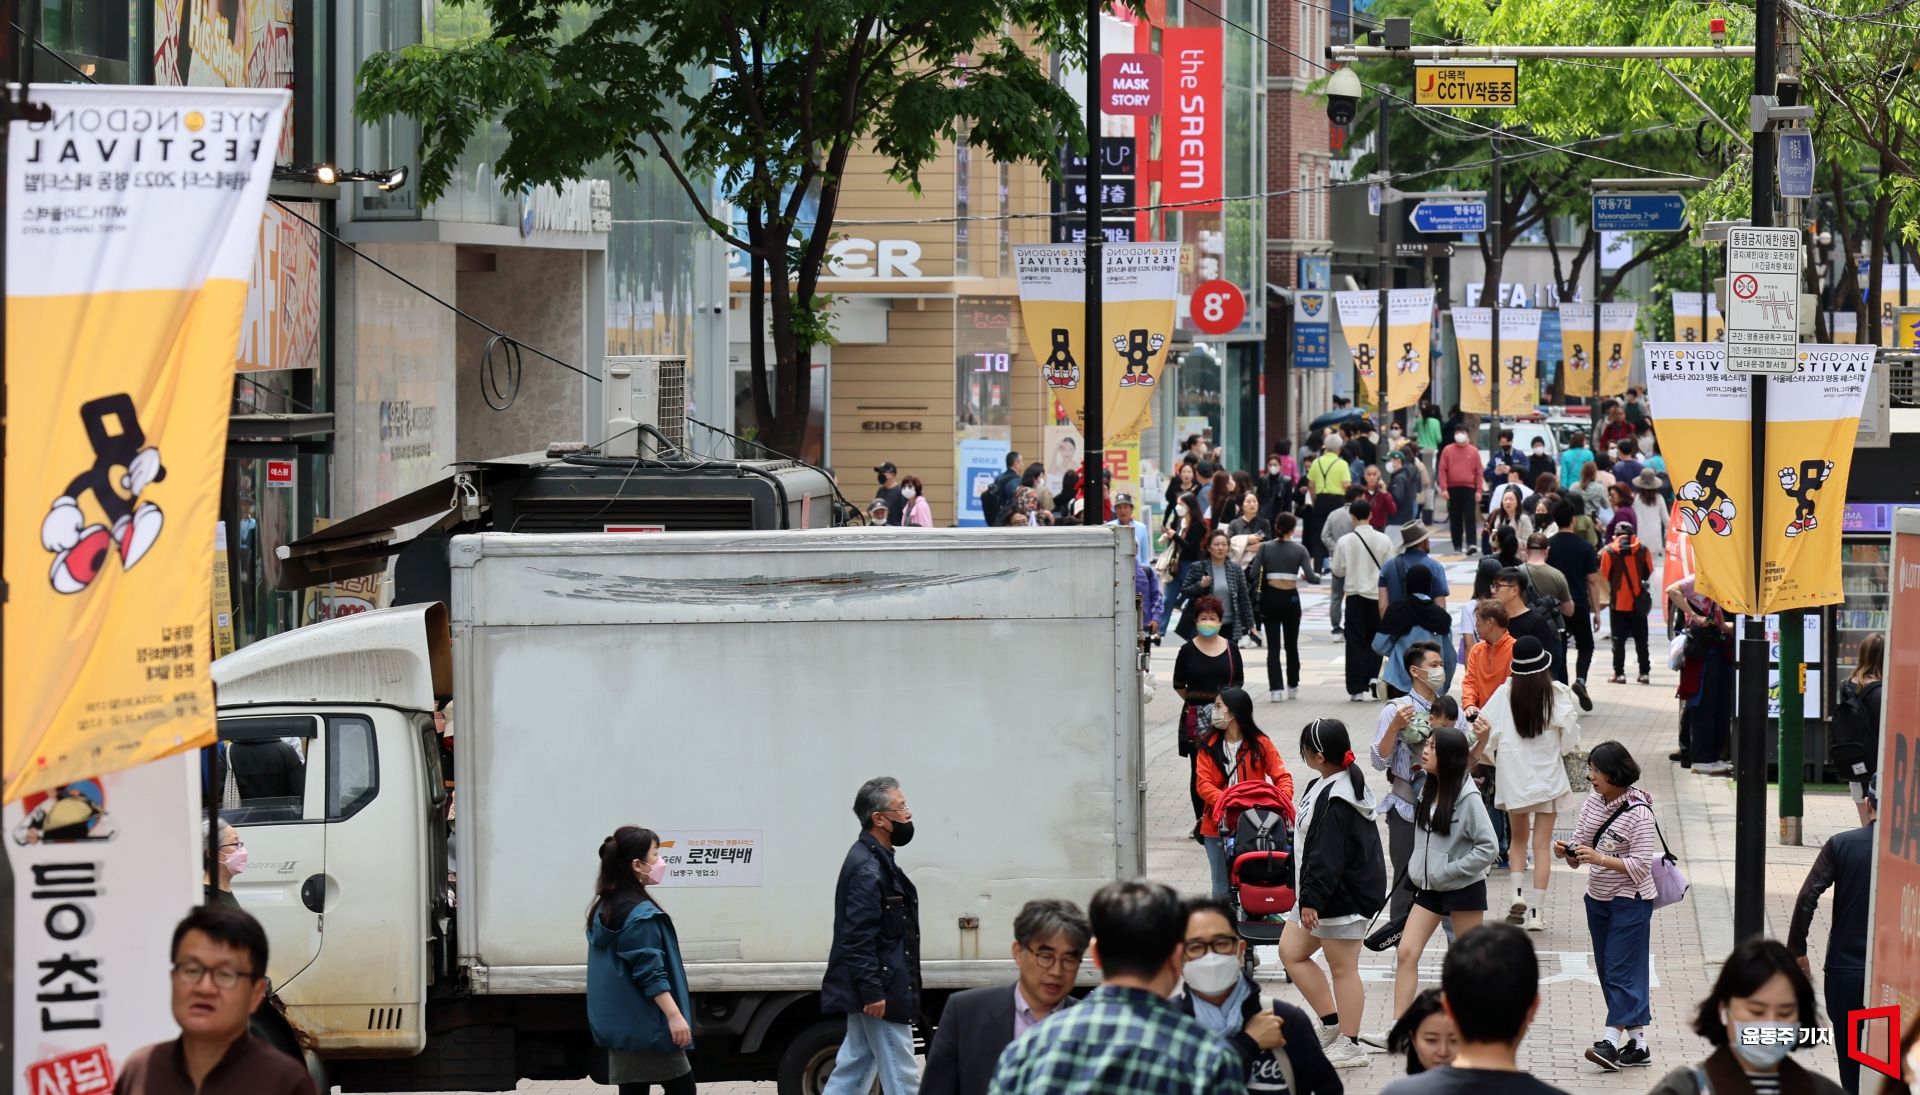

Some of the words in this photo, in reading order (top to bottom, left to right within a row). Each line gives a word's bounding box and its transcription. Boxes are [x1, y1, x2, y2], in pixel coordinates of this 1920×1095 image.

[1120, 62, 1144, 74] ALL
[1180, 49, 1204, 88] the
[1438, 70, 1466, 80] 다목적
[1113, 78, 1150, 90] MASK
[1437, 82, 1513, 102] CCTV작동중
[1111, 95, 1151, 107] STORY
[1597, 198, 1632, 210] 명동7길
[1429, 216, 1468, 224] Myeongdong
[1597, 212, 1642, 220] Myeongdong
[1643, 212, 1659, 220] 7-gil
[1072, 229, 1130, 243] 보게임
[1733, 232, 1796, 248] 통행금지(제한)알림
[826, 238, 922, 278] ER
[1466, 283, 1528, 308] FFA
[1546, 283, 1583, 308] 194
[1747, 332, 1781, 342] 명동관광특구
[1782, 333, 1794, 342] 일대
[1651, 350, 1725, 360] MYEONGDO
[1799, 351, 1870, 362] ONGDONG
[1651, 361, 1720, 371] FESTIV
[1736, 359, 1787, 369] 남대문경찰서장
[1798, 361, 1867, 372] STIVAL
[1652, 373, 1686, 382] 서울페스타
[1687, 373, 1705, 381] 2023
[1706, 373, 1719, 382] 명동
[1720, 373, 1747, 382] 페스티벌
[1772, 374, 1806, 383] 서울페스타
[1807, 374, 1825, 382] 2023
[1826, 373, 1840, 383] 명동
[861, 420, 923, 432] EIDER
[270, 468, 289, 477] 에스원
[1843, 512, 1862, 520] UMA
[662, 855, 682, 864] GEN
[686, 848, 753, 865] 로젠택배
[670, 869, 693, 878] (남동구
[695, 869, 719, 877] 영업소)
[1378, 931, 1403, 949] adida
[31, 861, 102, 1033] 등촌
